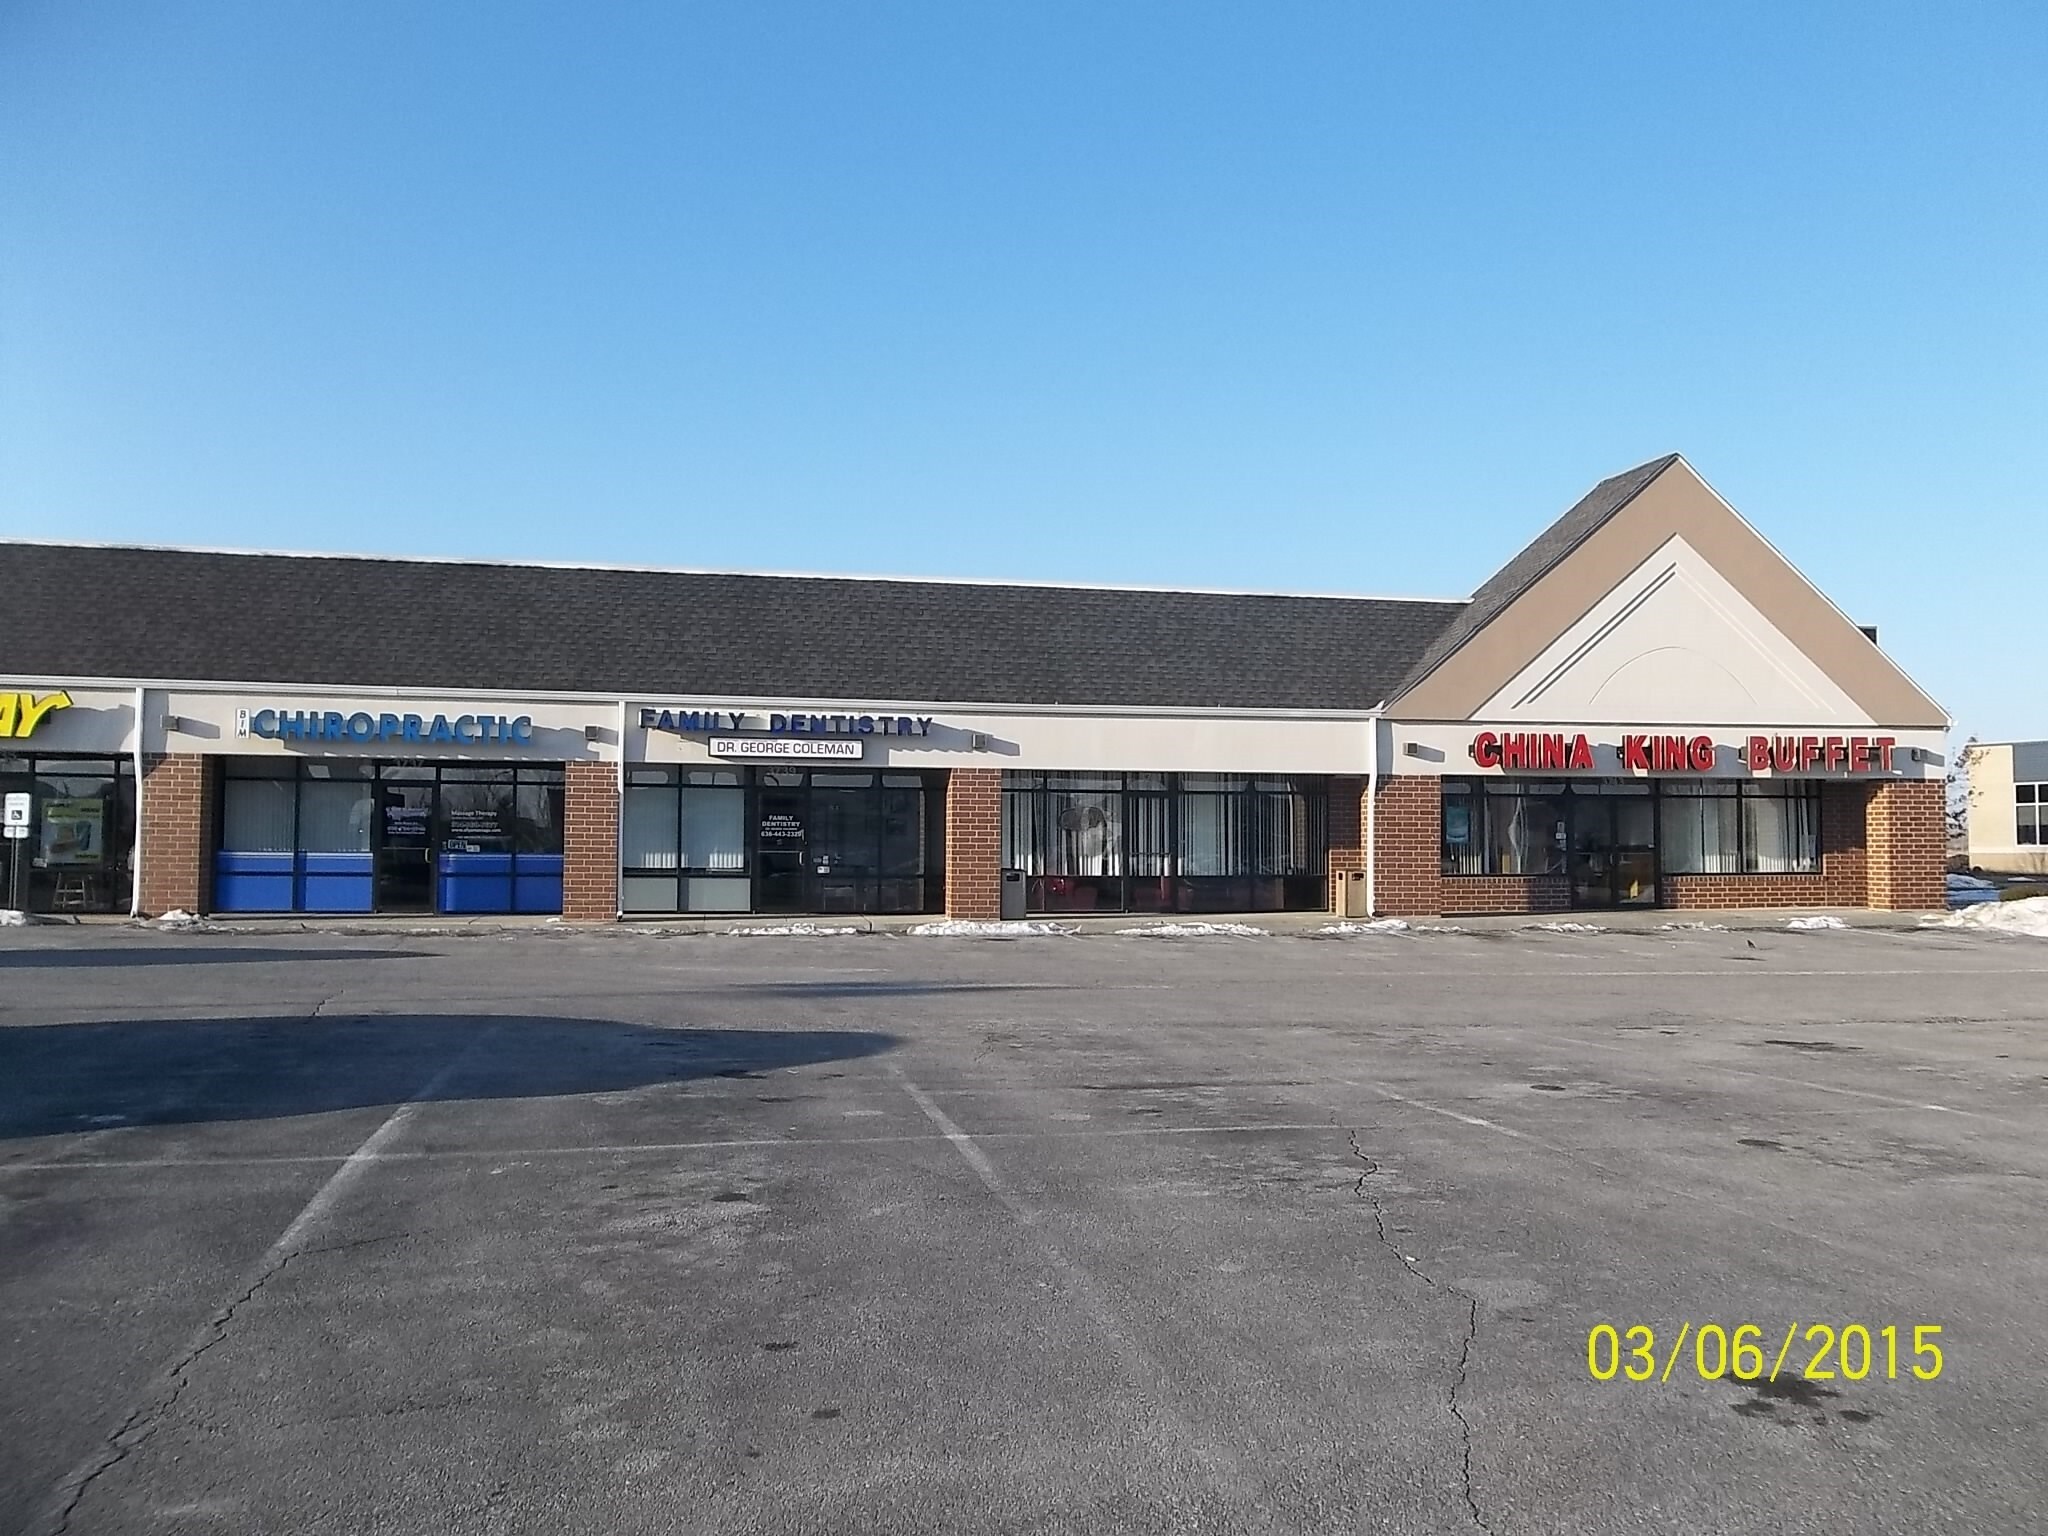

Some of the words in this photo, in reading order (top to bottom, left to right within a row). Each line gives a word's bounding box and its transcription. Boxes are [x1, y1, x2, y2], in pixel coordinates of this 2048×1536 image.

[253, 709, 533, 745] CHIROPRACTIC
[640, 708, 745, 731] FAMILY
[770, 714, 933, 736] DENTISTRY
[717, 741, 737, 753] DR.
[740, 742, 790, 753] GEORGE
[793, 743, 855, 755] COLEMAN
[1473, 731, 1595, 770] CHINA
[1622, 735, 1717, 771] KING
[1745, 736, 1897, 772] BUFFET
